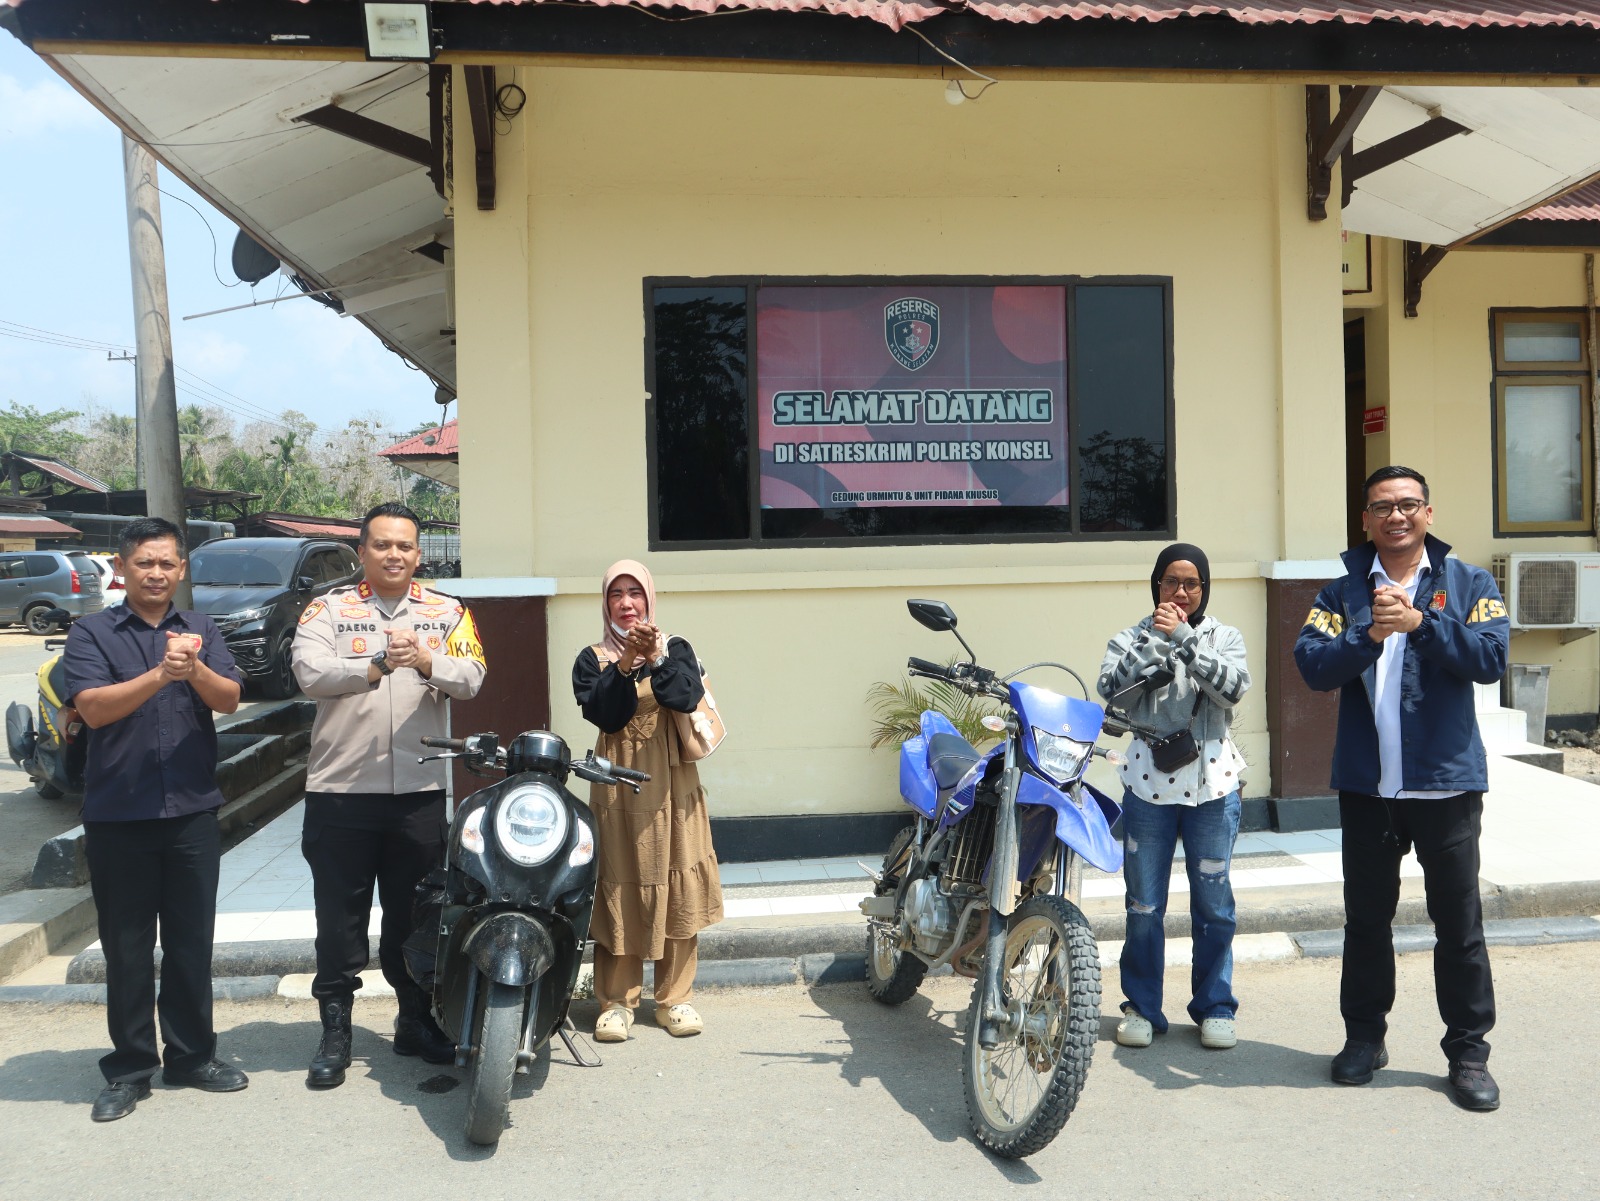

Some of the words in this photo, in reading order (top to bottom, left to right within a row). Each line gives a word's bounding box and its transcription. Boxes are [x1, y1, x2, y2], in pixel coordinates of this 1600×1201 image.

[887, 300, 937, 320] RESERSE
[898, 313, 926, 321] POLRES
[890, 343, 912, 368] KONAWE
[912, 343, 935, 368] SELATAN
[774, 391, 921, 424] SELAMAT
[926, 390, 1051, 423] DATANG
[775, 443, 795, 463] DI
[798, 442, 913, 463] SATRESKRIM
[916, 441, 983, 461] POLRES
[985, 440, 1052, 461] KONSEL
[831, 492, 865, 502] GEDUNG
[866, 491, 904, 501] URMINTU
[905, 491, 913, 501] &
[914, 491, 932, 501] UNIT
[934, 490, 964, 500] PIDANA
[965, 489, 999, 500] KHUSUS
[337, 623, 377, 633] DAENG
